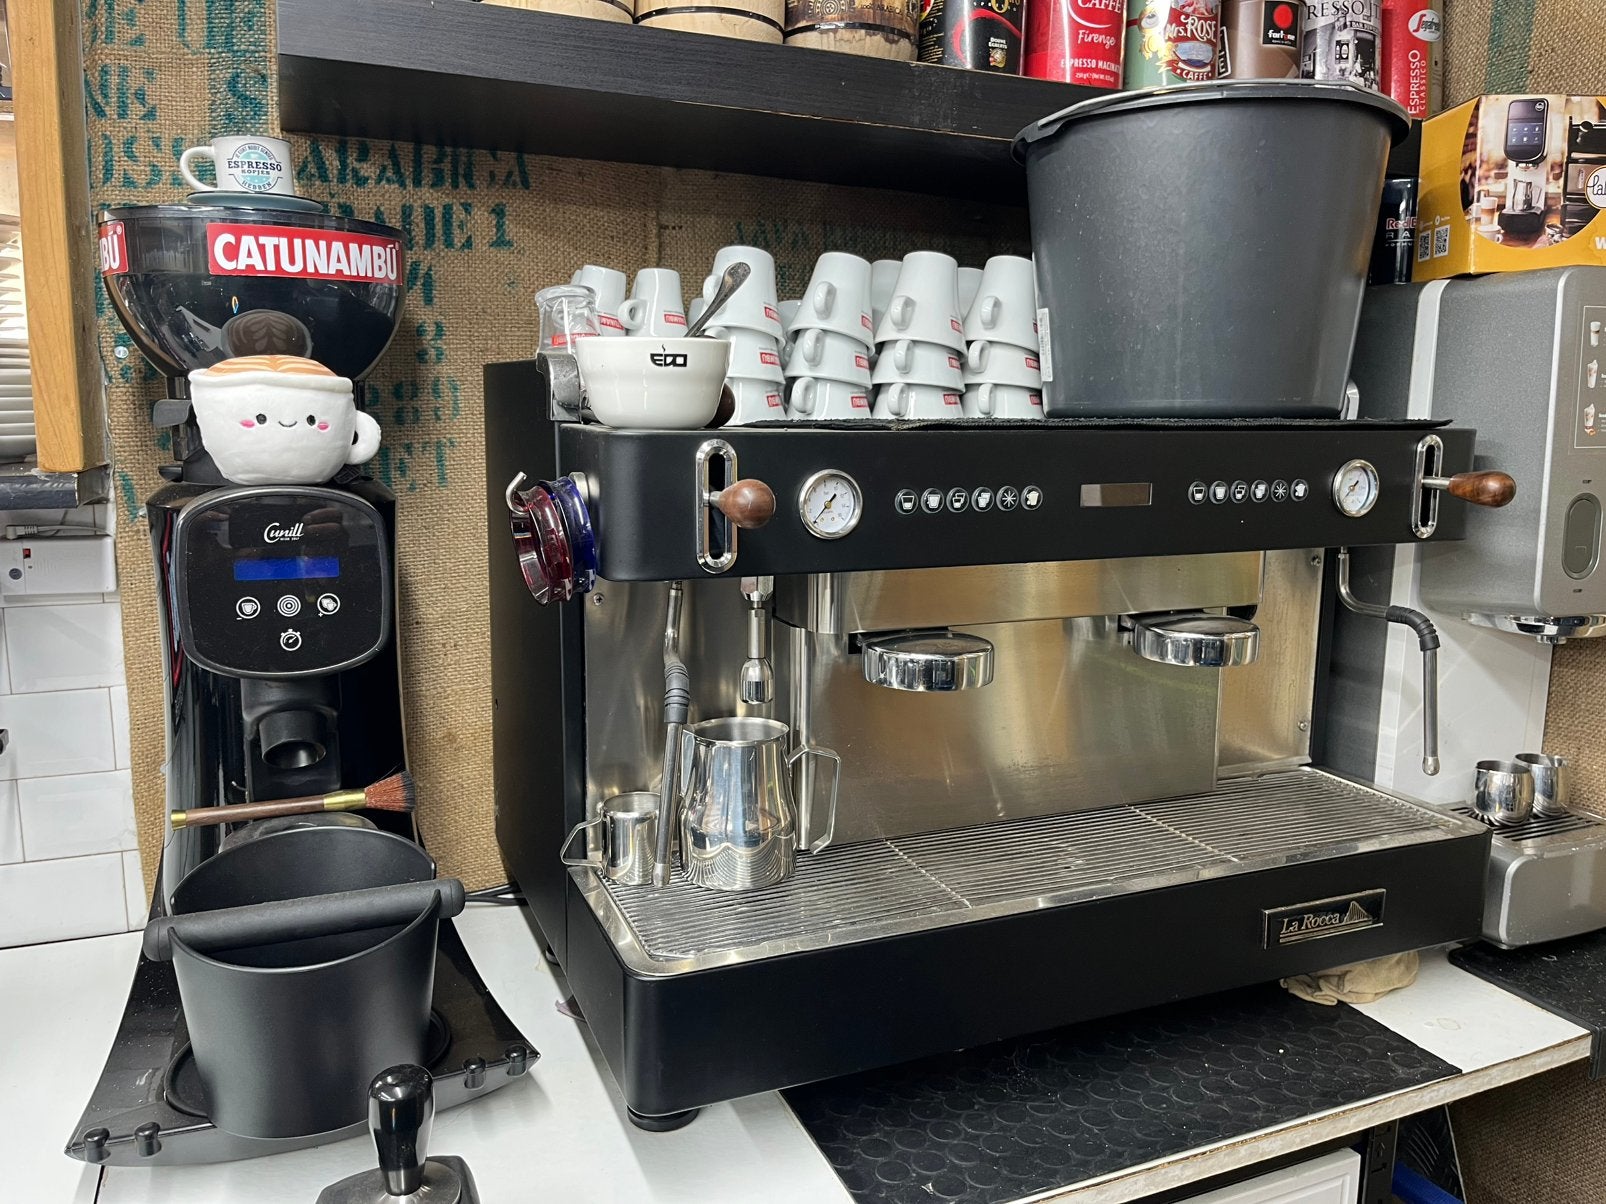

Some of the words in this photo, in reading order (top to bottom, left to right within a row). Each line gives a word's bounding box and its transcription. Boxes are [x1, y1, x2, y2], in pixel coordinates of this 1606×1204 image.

[1407, 50, 1421, 114] ESPRESSO
[227, 160, 282, 172] ESPRESSO
[263, 522, 305, 543] Cunill
[1281, 918, 1299, 934] La
[1301, 913, 1340, 930] Rocca
